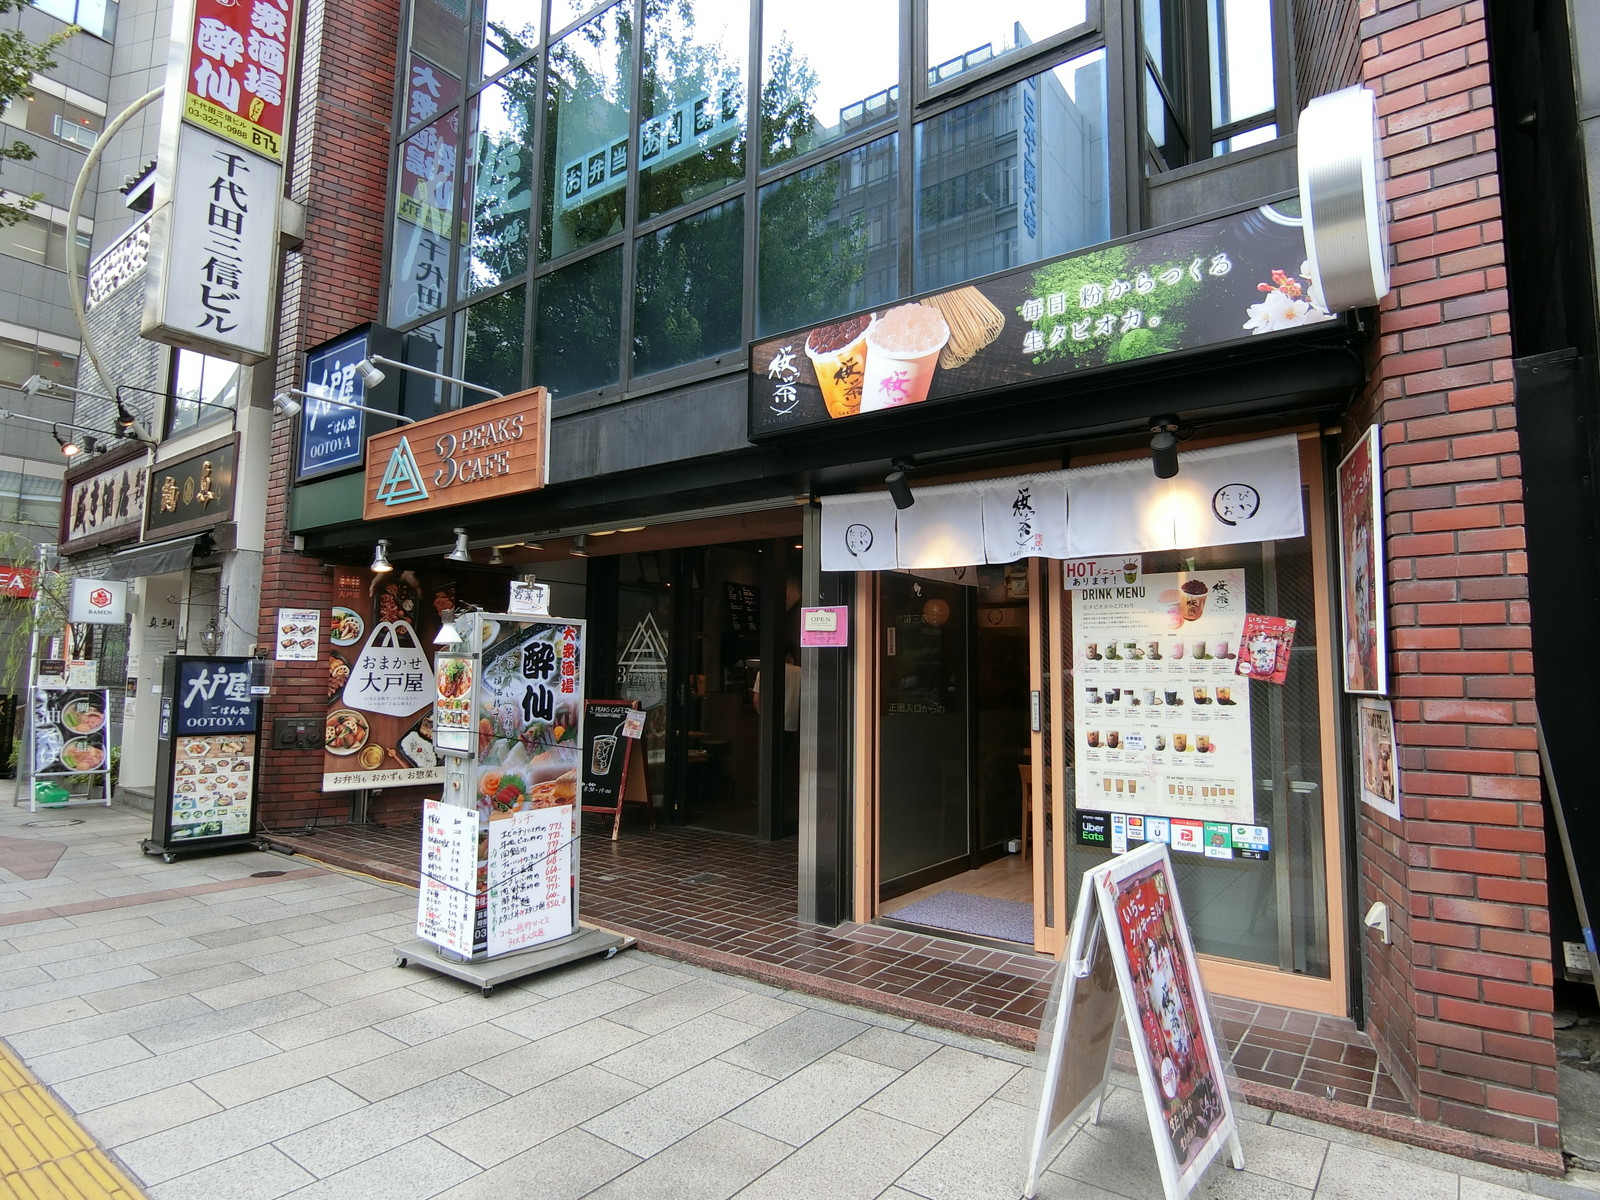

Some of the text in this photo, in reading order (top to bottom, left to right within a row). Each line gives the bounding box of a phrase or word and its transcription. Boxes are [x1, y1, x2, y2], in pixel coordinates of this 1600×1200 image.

[194, 17, 244, 113] 酔仙
[243, 0, 288, 106] 衆酒場
[188, 106, 248, 139] 03-3221-0988
[192, 98, 247, 129] 千代田三信ビル
[195, 149, 250, 334] 千代田三信ビル
[1023, 253, 1232, 322] 毎日 粉からつくる
[1023, 309, 1160, 353] 生タピオカ。
[310, 436, 351, 459] OOTOYA
[434, 414, 524, 489] 3 PEAKS
[458, 450, 510, 483] CAFE
[1066, 562, 1122, 578] HOT メニュー
[1082, 586, 1145, 600] DRINK MENU
[1248, 616, 1270, 624] いちご
[1248, 623, 1290, 631] クッキーミルク
[361, 655, 423, 670] おまかせ
[560, 626, 576, 694] 大衆酒場
[617, 665, 627, 684] 3
[183, 666, 251, 709] 大戸屋
[359, 671, 424, 693] 大戸屋
[521, 641, 556, 723] 酔仙
[186, 717, 246, 728] OOTOYA
[333, 769, 439, 785] お弁当も おかずも お惣菜も
[1082, 822, 1104, 832] Uber
[1082, 831, 1104, 841] Eats
[1177, 840, 1197, 848] PayPay
[1122, 888, 1145, 925] いちご
[1129, 896, 1165, 946] クッキーミルク
